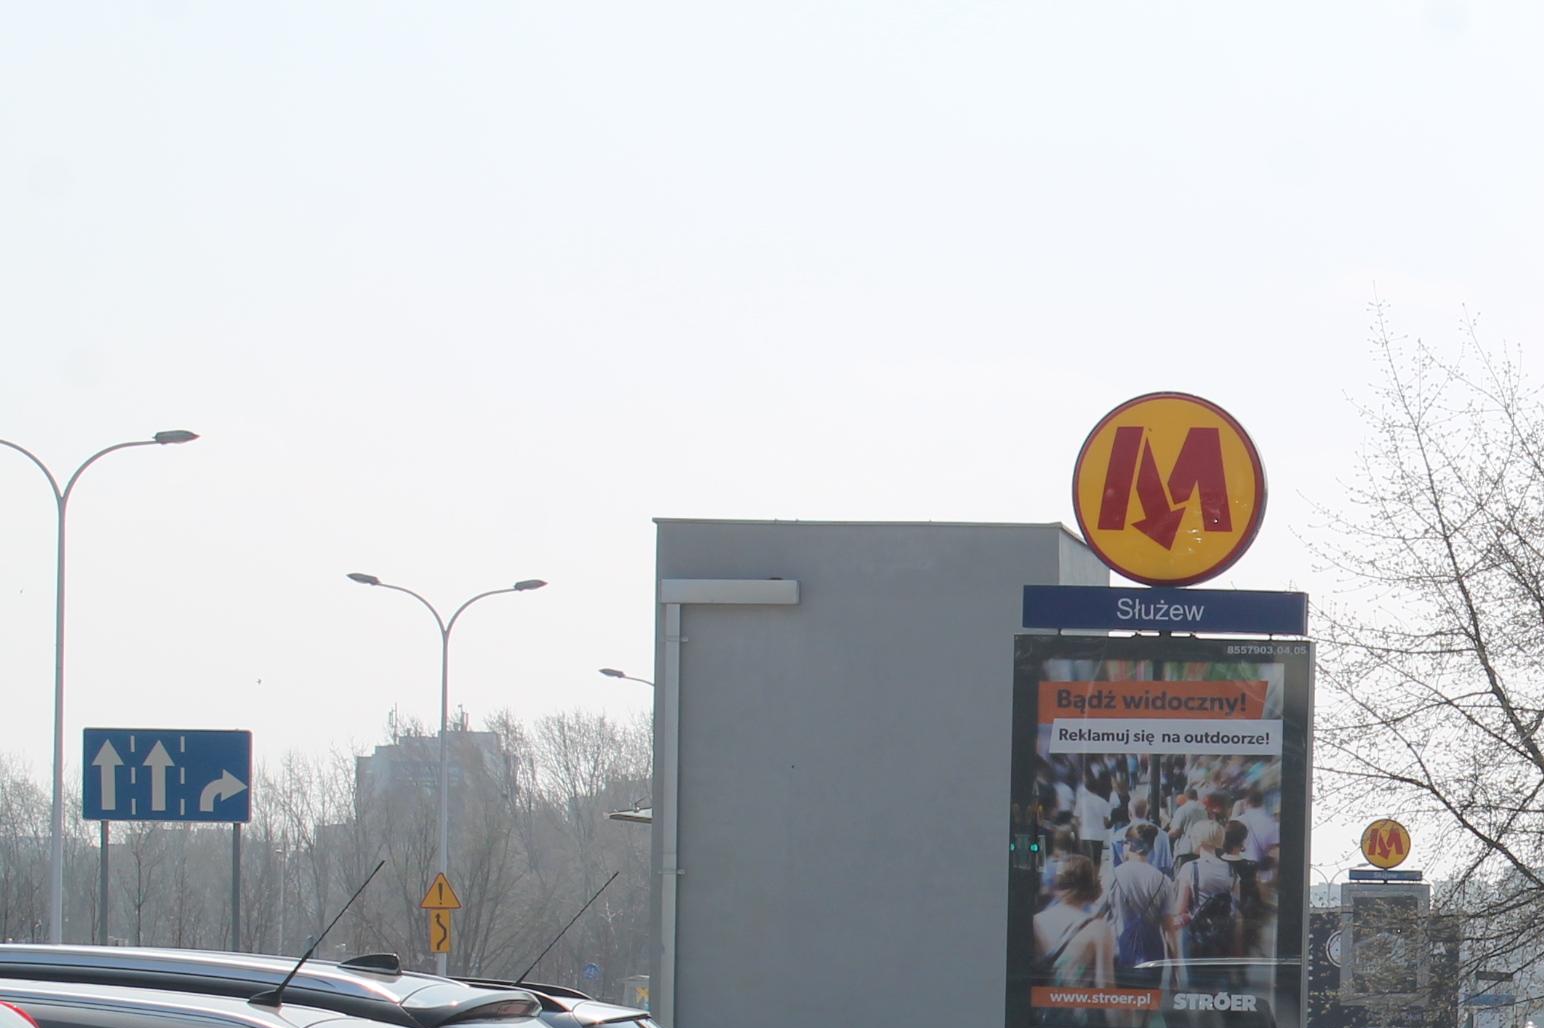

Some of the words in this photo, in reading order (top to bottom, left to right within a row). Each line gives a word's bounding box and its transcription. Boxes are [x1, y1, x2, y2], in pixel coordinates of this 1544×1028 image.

[1116, 597, 1205, 621] Służew
[1056, 688, 1117, 714] Bądź
[1122, 690, 1248, 715] widoczny!
[1058, 728, 1130, 745] Reklamuj
[1133, 729, 1156, 746] się
[1161, 732, 1181, 744] na
[1184, 732, 1271, 746] outdoorze!
[1049, 991, 1152, 1006] www.stroer.pl
